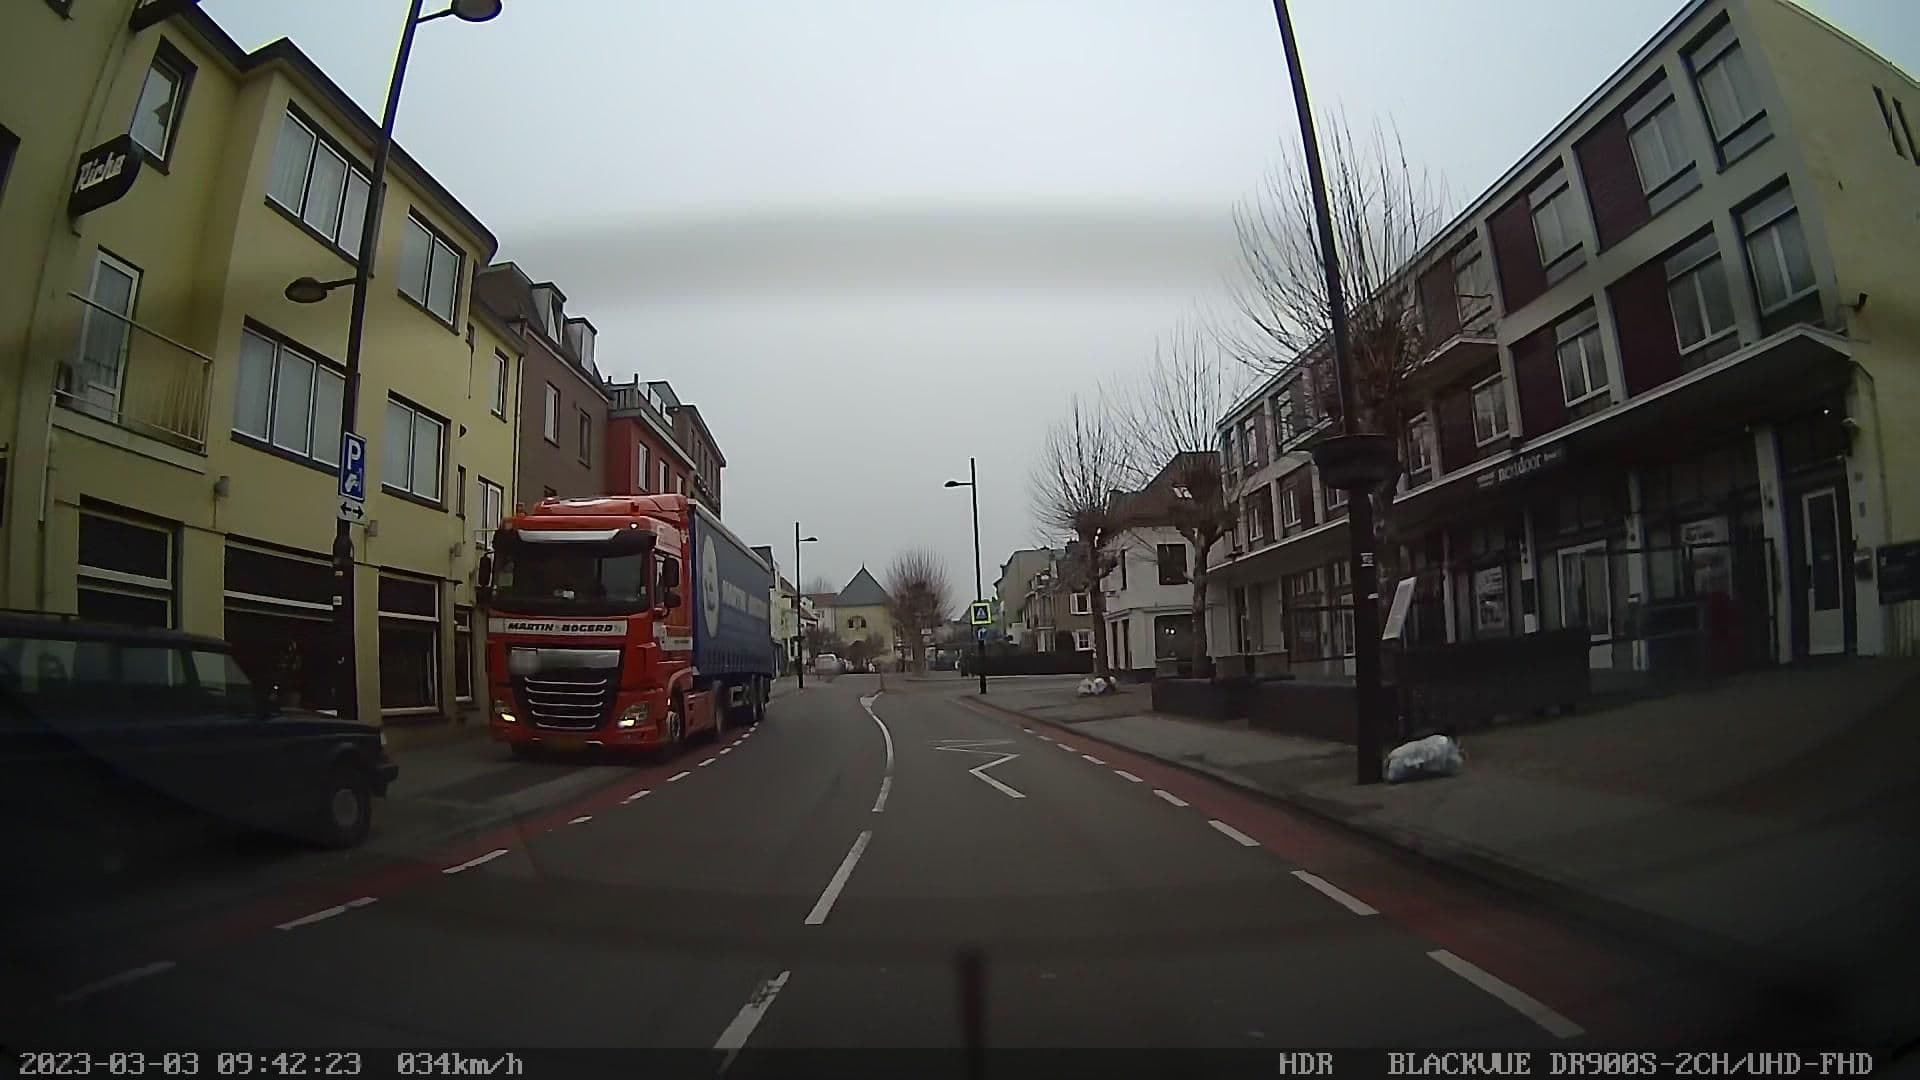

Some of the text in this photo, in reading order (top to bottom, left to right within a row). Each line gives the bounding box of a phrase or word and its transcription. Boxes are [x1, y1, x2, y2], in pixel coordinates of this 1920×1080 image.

[347, 438, 361, 470] P
[507, 622, 613, 632] MARTIN BOGERD
